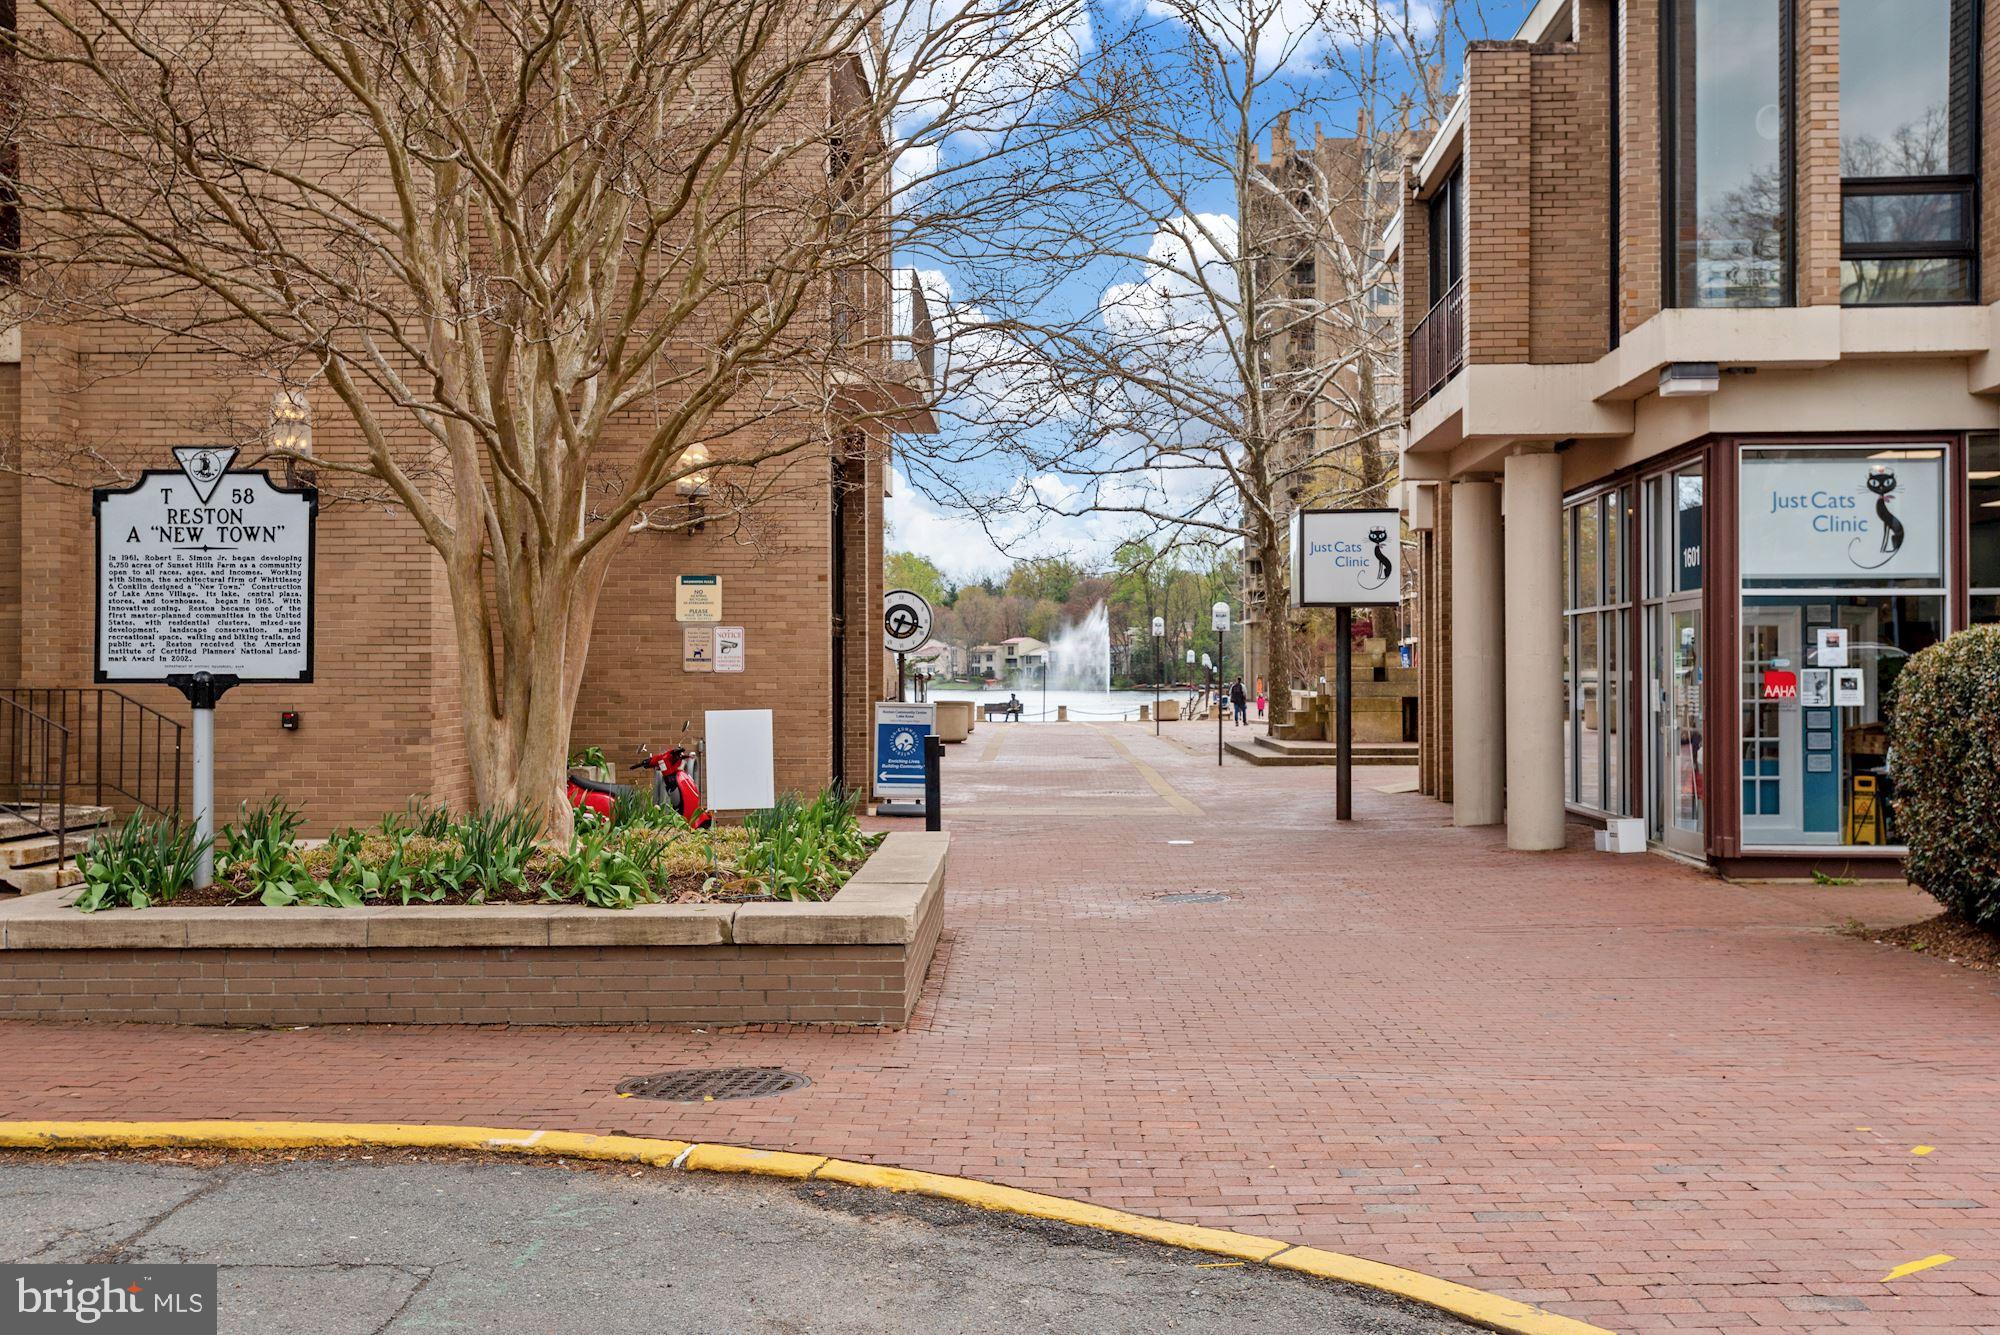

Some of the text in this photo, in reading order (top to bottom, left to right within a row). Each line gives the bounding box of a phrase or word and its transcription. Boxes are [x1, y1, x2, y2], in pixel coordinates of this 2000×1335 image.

[161, 488, 255, 504] T 58
[1770, 491, 1856, 514] Just Cats
[167, 508, 243, 525] RESTON
[1812, 514, 1868, 533] Clinic
[126, 526, 141, 543] A
[1309, 541, 1362, 556] Just Cats
[1335, 556, 1370, 567] Clinic
[1683, 545, 1700, 568] 1601
[258, 562, 302, 570] community
[270, 569, 302, 577] Working
[215, 598, 238, 606] began
[108, 641, 132, 649] public
[186, 634, 216, 642] walking
[233, 634, 258, 642] biking
[108, 647, 142, 655] Institute
[1764, 684, 1797, 698] AAHA
